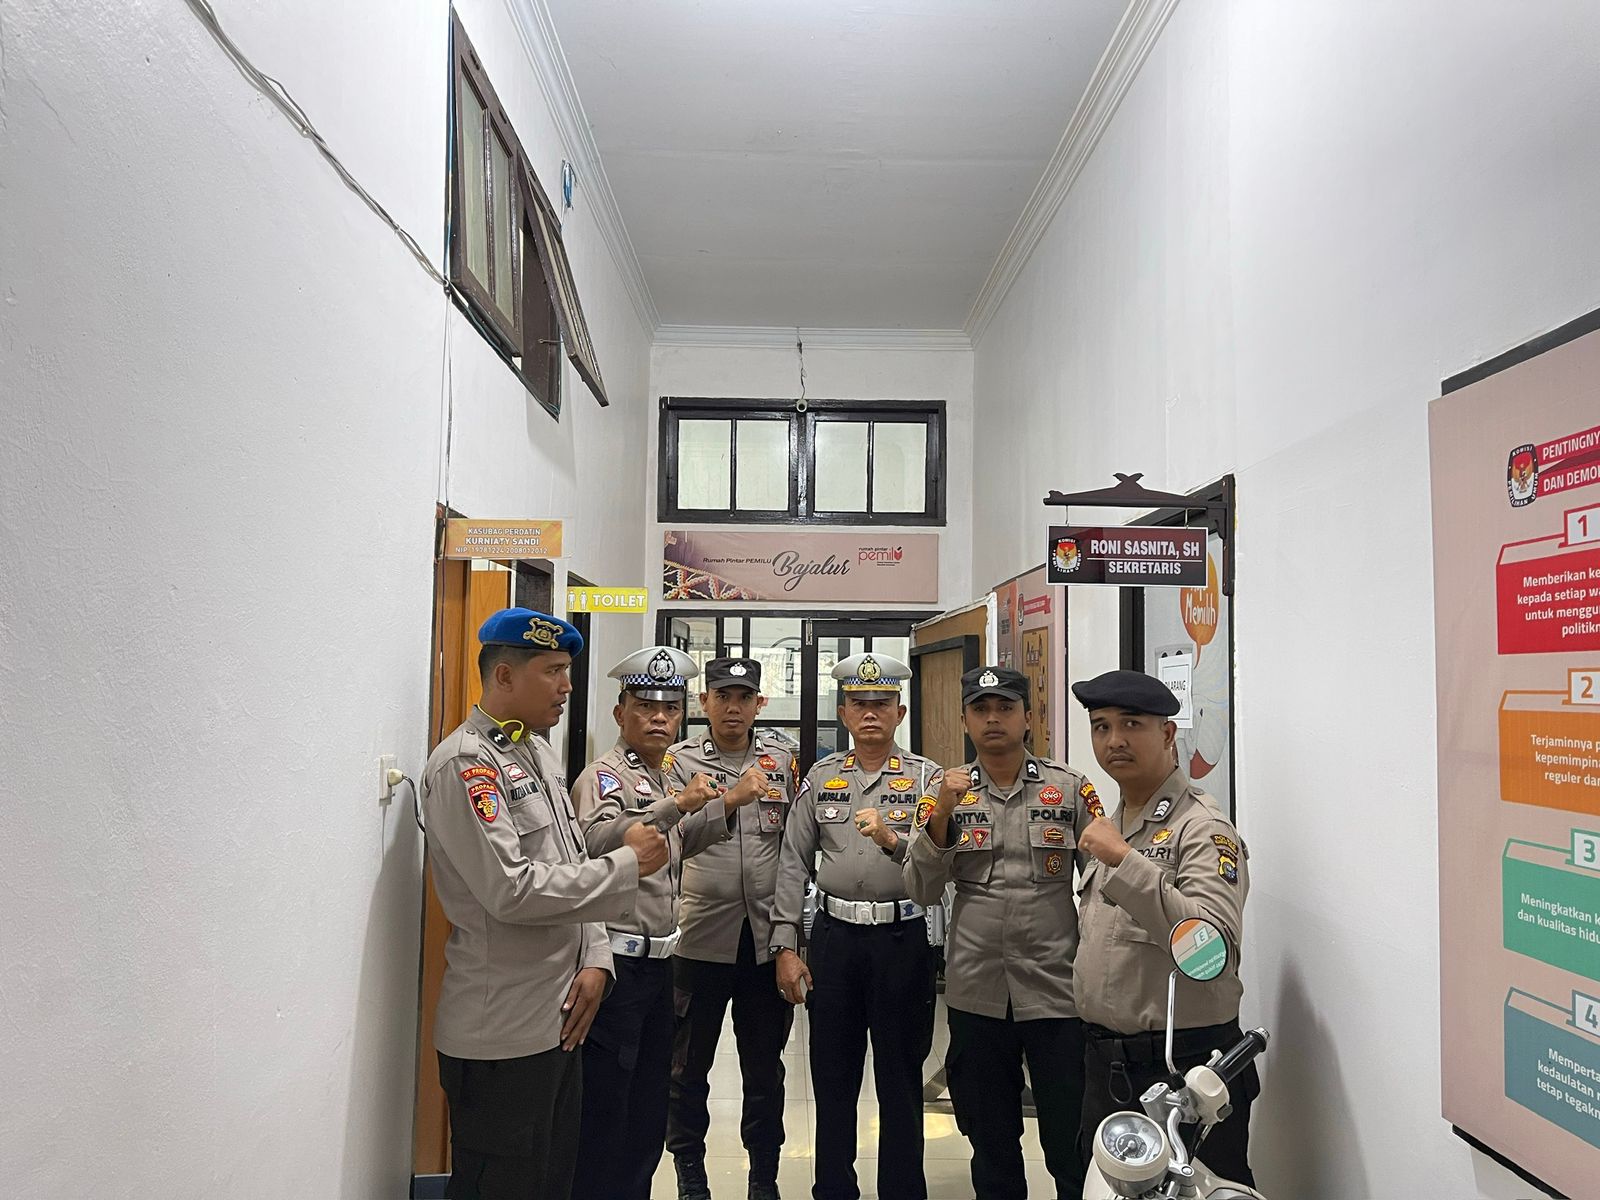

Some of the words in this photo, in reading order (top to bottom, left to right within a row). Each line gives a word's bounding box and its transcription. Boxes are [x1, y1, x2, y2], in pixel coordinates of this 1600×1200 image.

[1544, 475, 1564, 492] DAN
[1578, 514, 1587, 537] 1
[465, 537, 510, 545] KURNIATY
[512, 538, 539, 546] SANDI
[1090, 540, 1121, 555] RONI
[1124, 540, 1180, 559] SASNITA,
[1183, 542, 1200, 557] SH
[771, 550, 851, 592] Bajalur
[1108, 561, 1182, 575] SEKRETARIS
[1523, 571, 1586, 588] Memberikan
[592, 594, 645, 607] TOILET
[1517, 591, 1553, 606] kepada
[1554, 588, 1587, 601] setiap
[1525, 607, 1554, 621] untuk
[1556, 605, 1600, 619] menggu
[1580, 676, 1594, 699] 2
[1530, 734, 1593, 752] Terjaminnya
[1535, 751, 1600, 770] kepemimpin
[1544, 772, 1582, 785] reguler
[817, 792, 851, 803] MUSLIM
[880, 793, 917, 804] POLRI
[953, 812, 989, 825] DITYA
[1030, 809, 1072, 822] POLRI
[1583, 839, 1596, 863] 3
[1520, 893, 1592, 924] Meningkatkan
[1517, 909, 1535, 924] dan
[1537, 914, 1577, 937] kualitas
[1585, 1004, 1599, 1029] 4
[1537, 1060, 1594, 1098] kedaulatan
[1537, 1077, 1563, 1101] tetap
